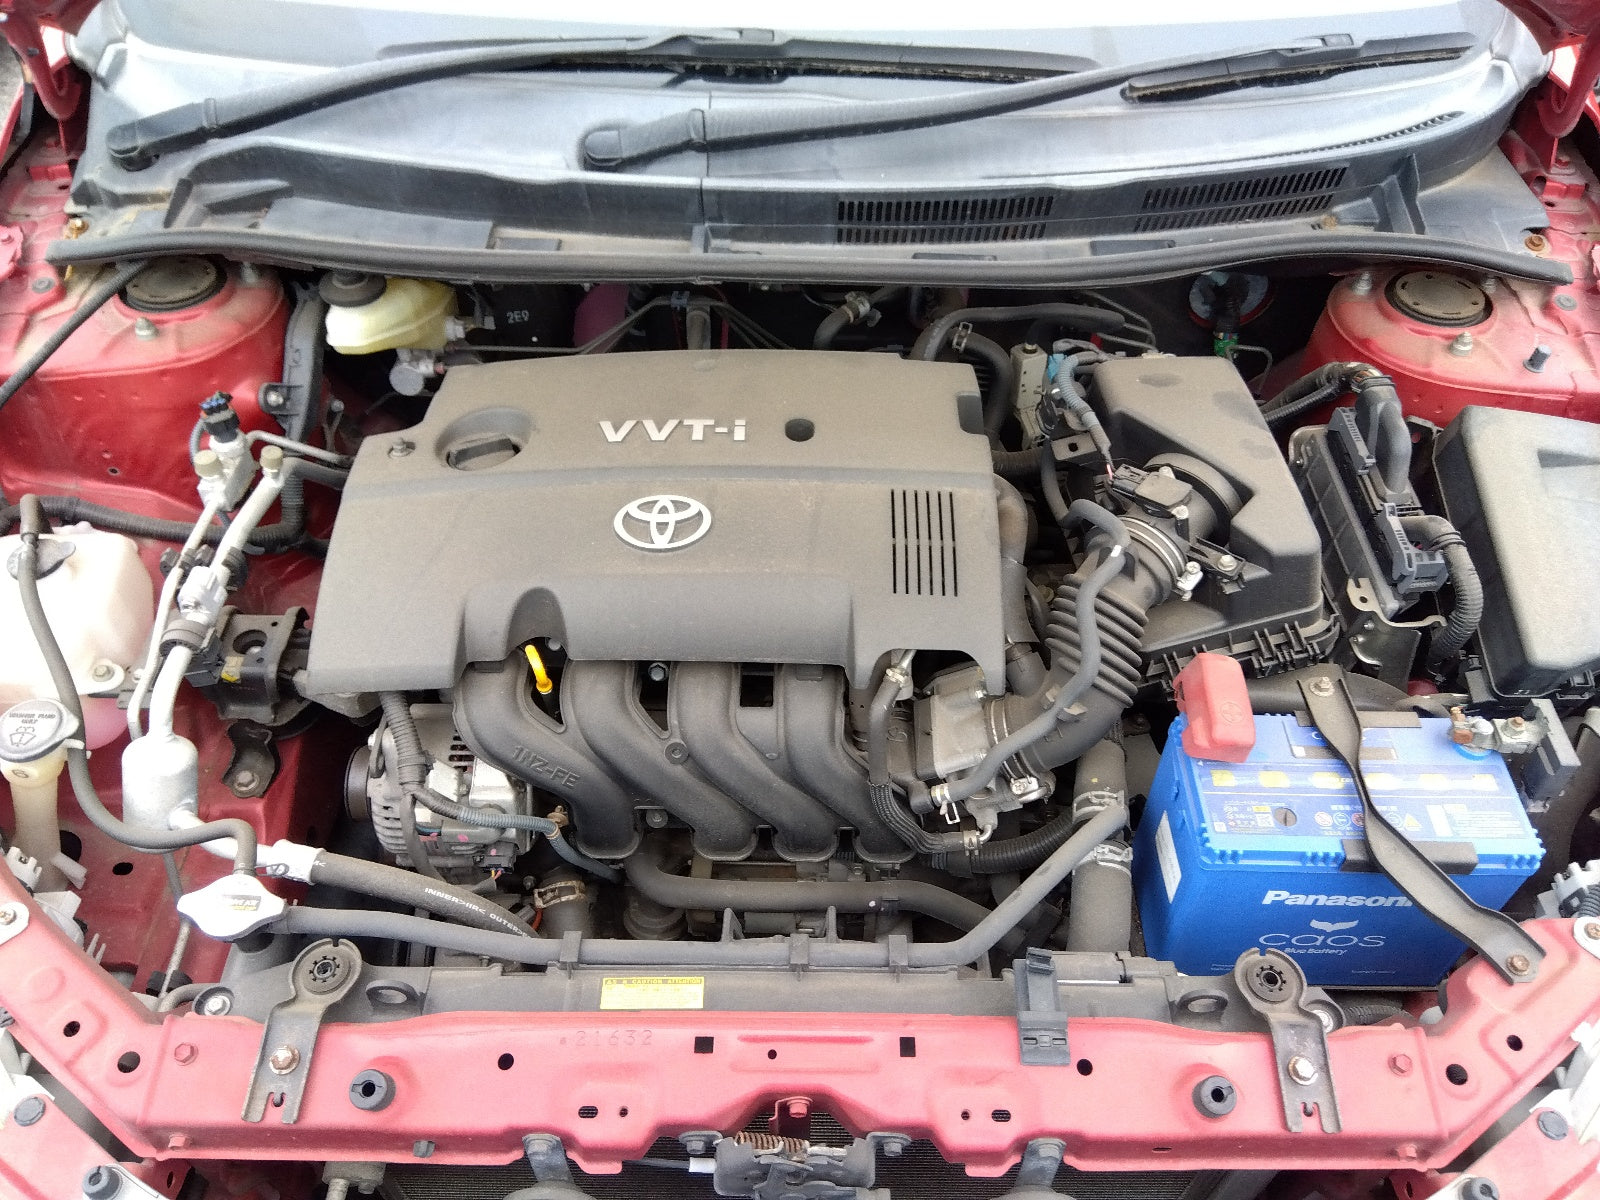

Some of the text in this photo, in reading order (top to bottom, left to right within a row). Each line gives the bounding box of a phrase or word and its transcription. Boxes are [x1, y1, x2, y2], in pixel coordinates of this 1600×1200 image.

[599, 418, 746, 443] VVT-i
[511, 745, 581, 789] 1NZ-FE
[1259, 933, 1387, 947] caos
[1306, 948, 1349, 956] Battery
